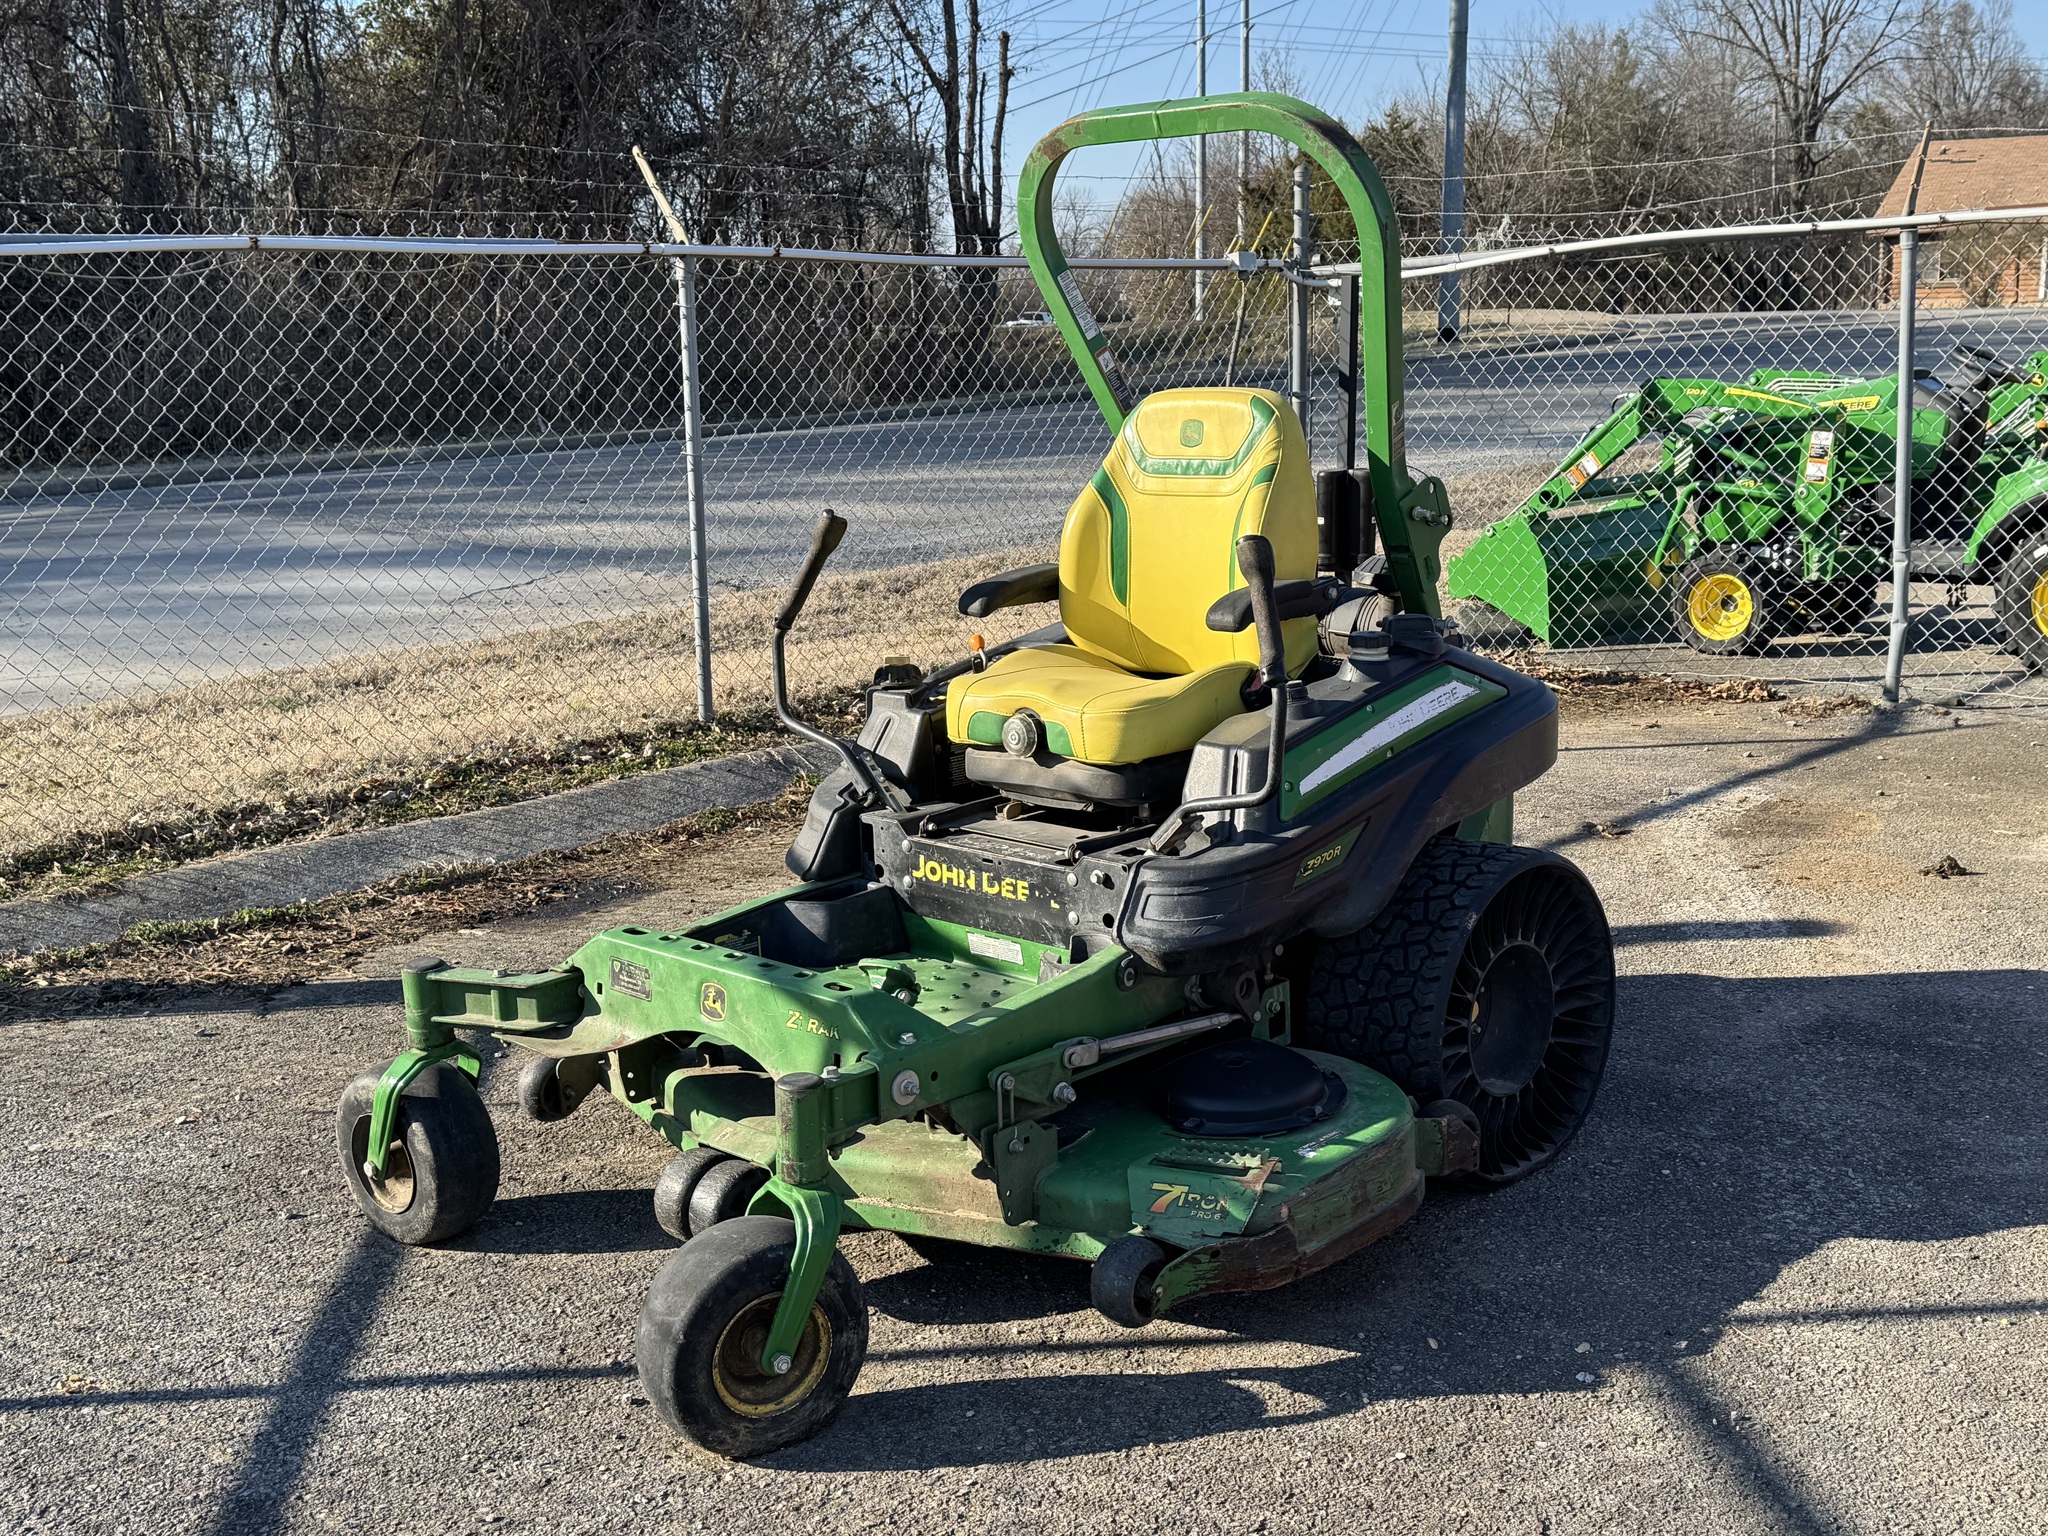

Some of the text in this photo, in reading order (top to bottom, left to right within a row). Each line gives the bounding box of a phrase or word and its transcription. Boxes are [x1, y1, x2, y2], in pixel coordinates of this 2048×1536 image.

[912, 854, 976, 891] JOHN
[1190, 1210, 1222, 1220] PRO 6
